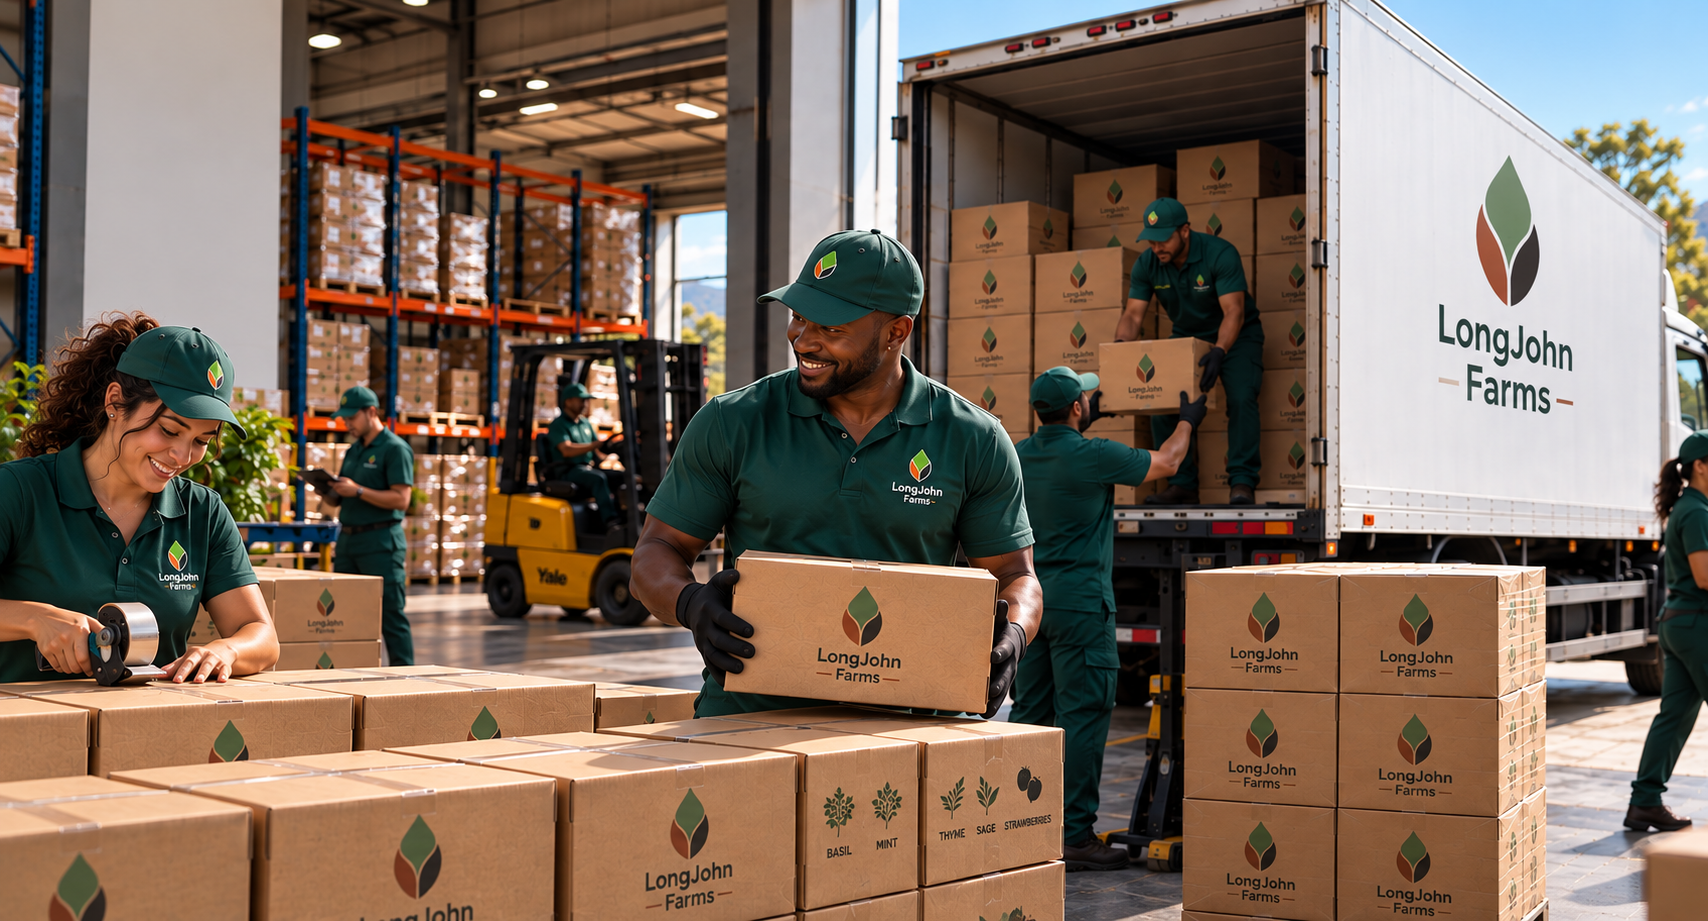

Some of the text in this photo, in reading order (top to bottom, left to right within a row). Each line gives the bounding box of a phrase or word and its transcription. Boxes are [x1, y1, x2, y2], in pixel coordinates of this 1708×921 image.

[1439, 303, 1573, 372] LongJohn
[1467, 363, 1551, 414] Farms
[892, 481, 943, 497] LongJohn
[903, 494, 931, 506] Farms
[158, 572, 199, 584] LongJohn
[537, 567, 568, 586] Yale
[817, 647, 901, 669] LongJohn
[1230, 646, 1299, 662] LongJohn
[1379, 650, 1454, 667] LongJohn
[836, 668, 881, 684] Farms
[1245, 662, 1282, 675] Farms
[1396, 665, 1437, 679] Farms
[1228, 760, 1297, 777] LongJohn
[1378, 767, 1453, 785] LongJohn
[1243, 776, 1281, 790] Farms
[1394, 784, 1436, 798] Farms
[939, 828, 966, 841] THYME
[976, 823, 996, 835] SAGE
[826, 837, 898, 859] BASIL MINT
[645, 861, 733, 892] LongJohn
[1226, 872, 1296, 891] LongJohn
[665, 890, 715, 911] Farms
[1241, 889, 1280, 904] Farms
[1377, 885, 1452, 904] LongJohn
[1393, 901, 1435, 917] Farms
